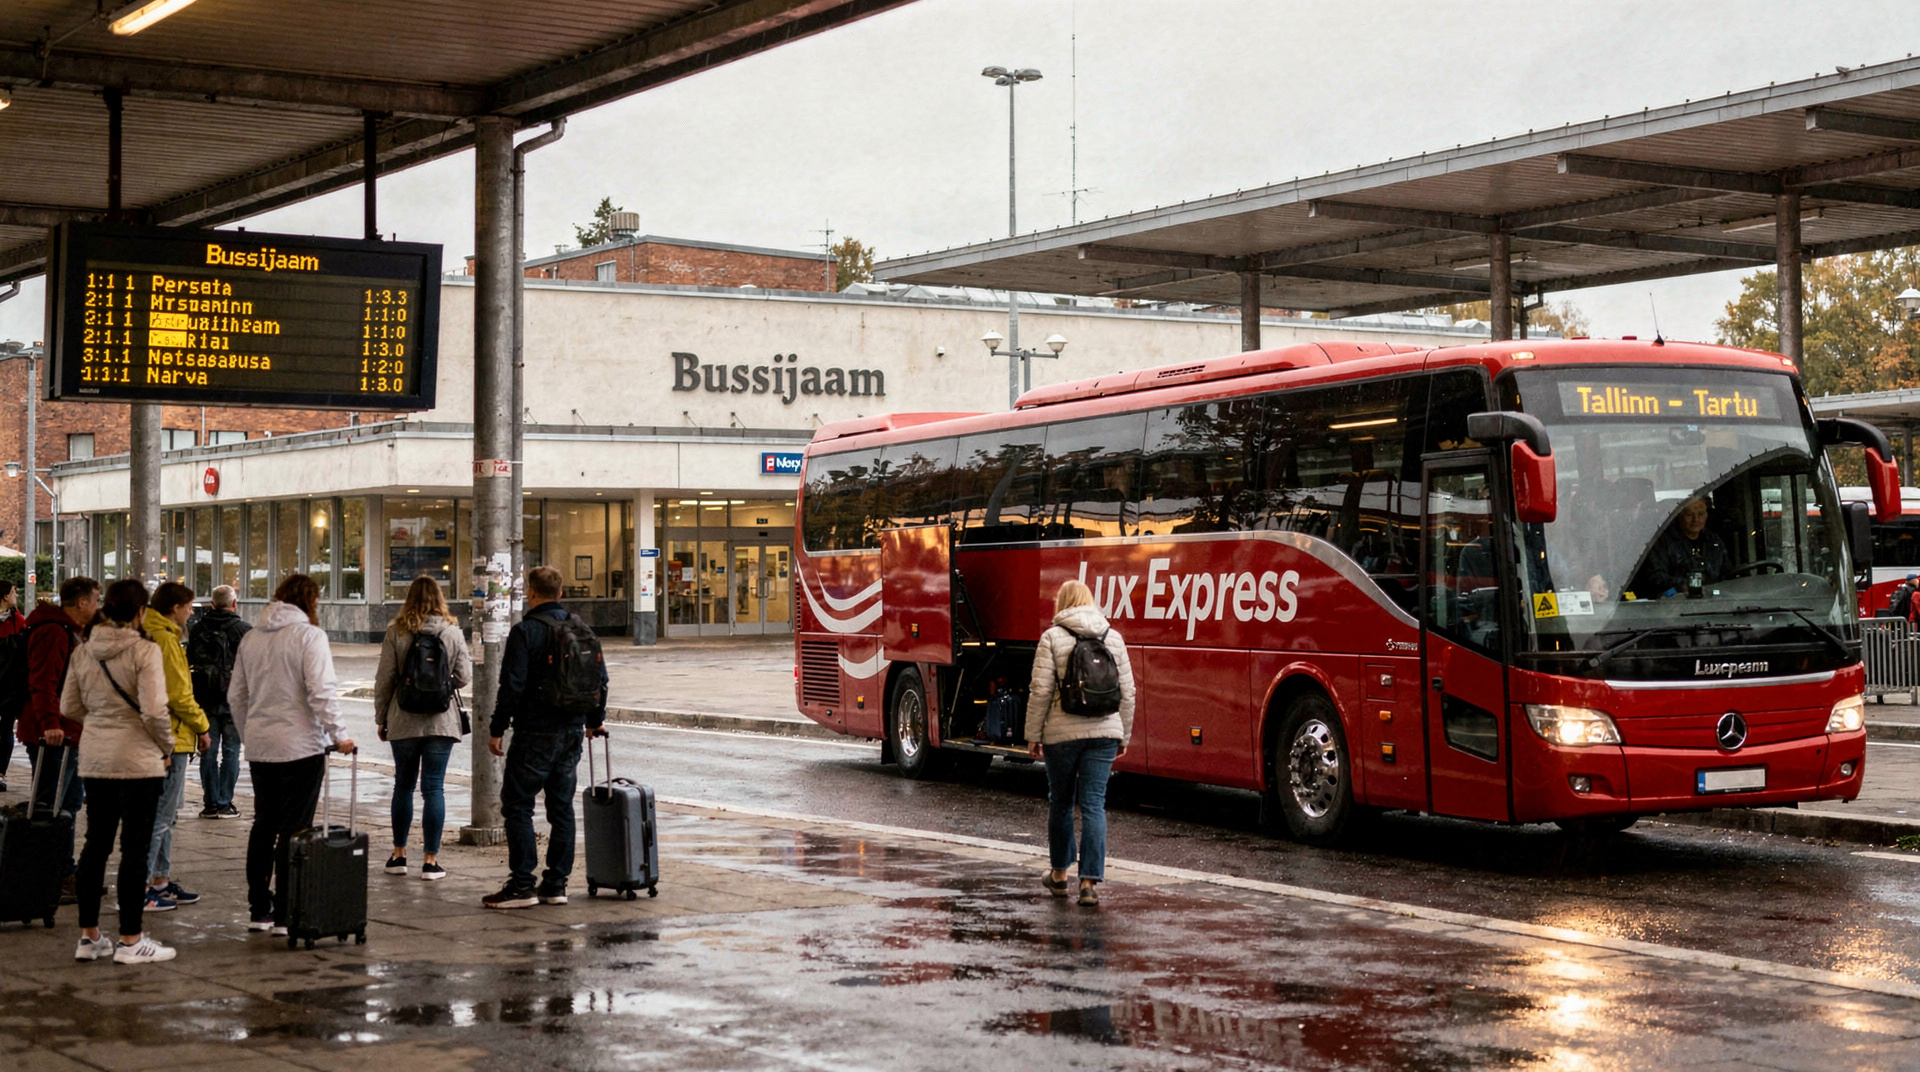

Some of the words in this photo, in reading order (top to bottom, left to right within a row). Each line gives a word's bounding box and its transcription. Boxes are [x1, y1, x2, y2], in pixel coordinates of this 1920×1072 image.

[206, 244, 319, 271] Bussijaam
[365, 289, 407, 305] 1:3.3
[364, 307, 407, 322] 1:1:0
[363, 324, 406, 339] 1:1:0
[363, 341, 404, 357] 1:3.0
[361, 358, 404, 374] 1:2:0
[147, 367, 208, 385] Narva
[360, 376, 403, 392] 1:3.0
[671, 352, 886, 405] Bussijaam
[1577, 387, 1659, 414] Tallinn
[1693, 389, 1758, 416] Tartu
[1144, 558, 1300, 641] Express
